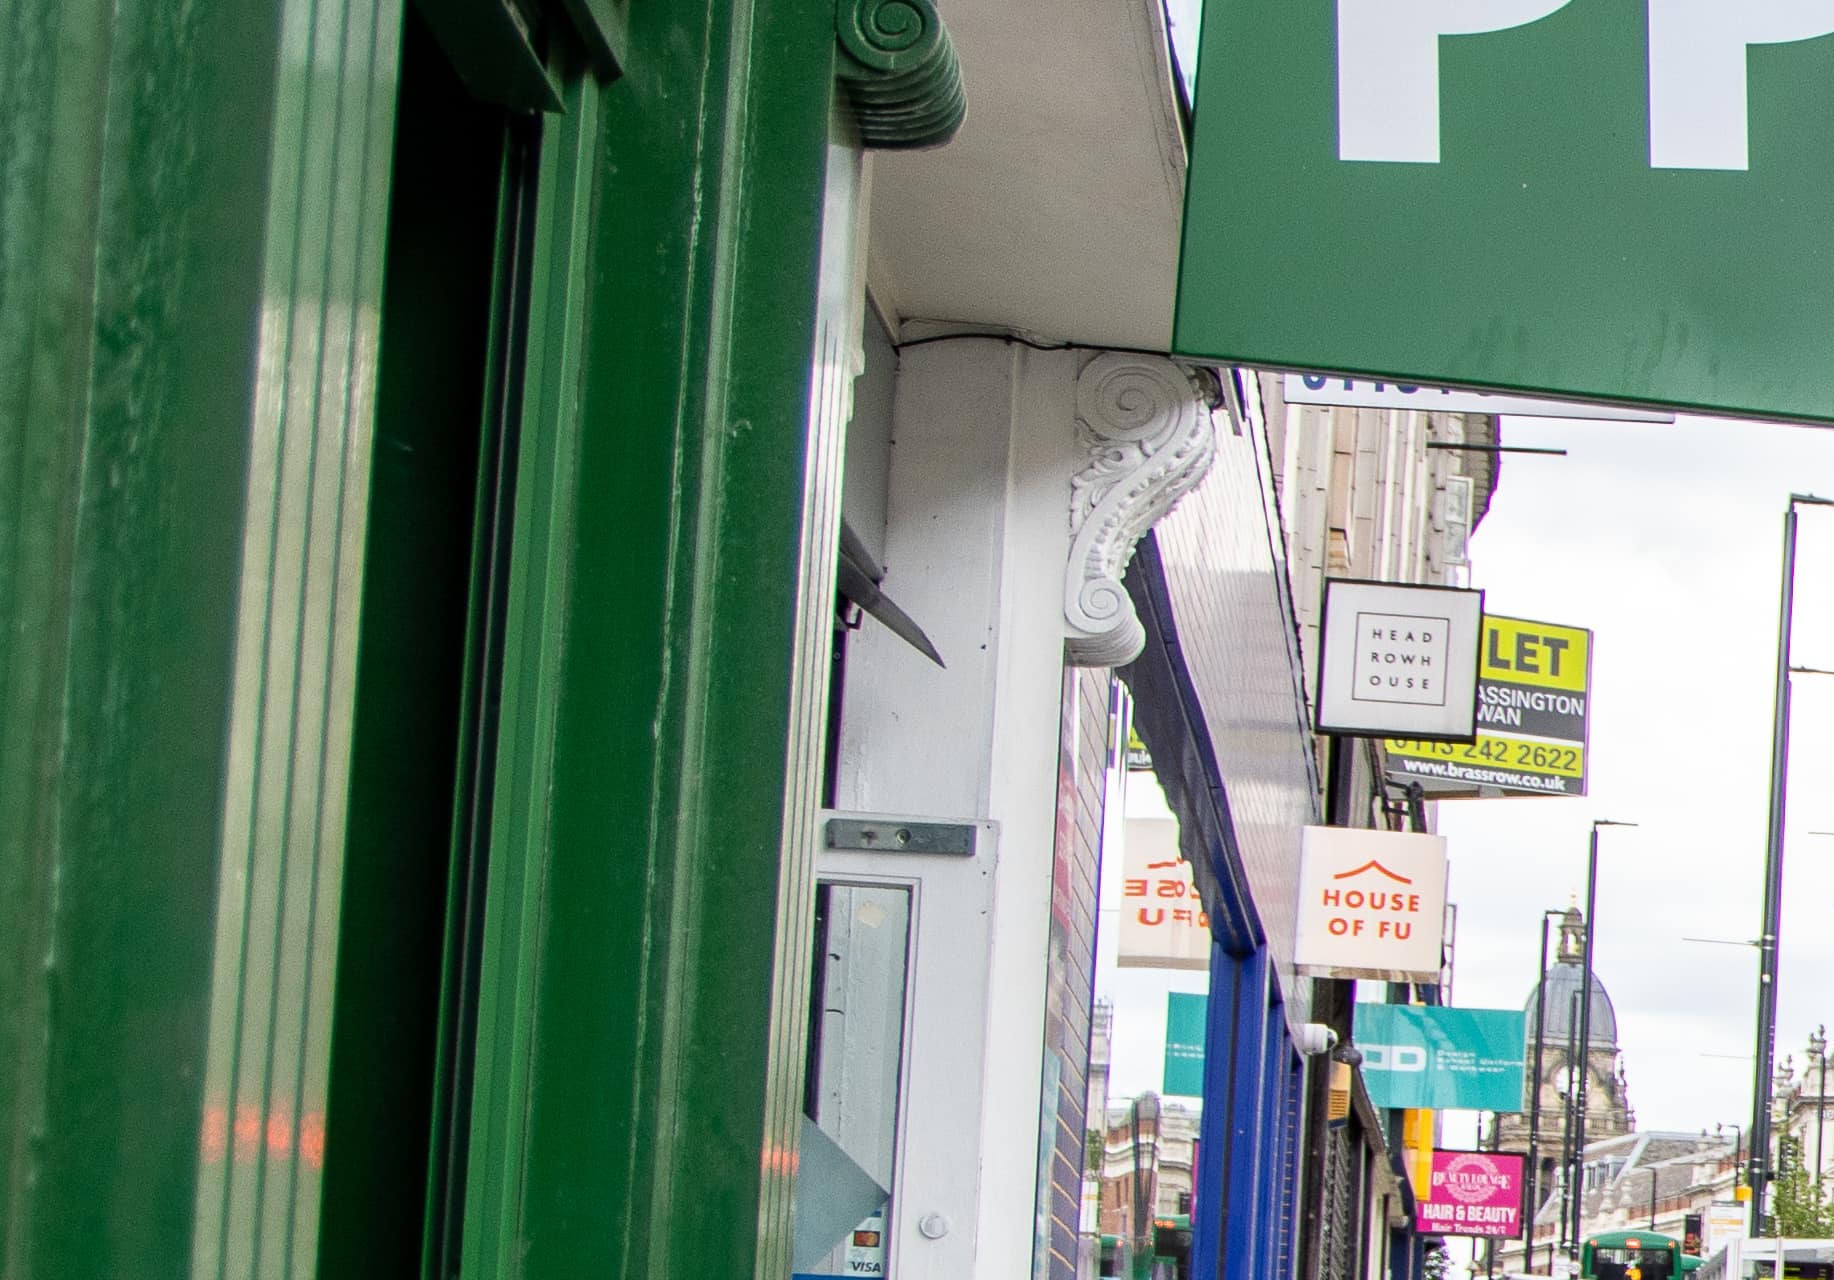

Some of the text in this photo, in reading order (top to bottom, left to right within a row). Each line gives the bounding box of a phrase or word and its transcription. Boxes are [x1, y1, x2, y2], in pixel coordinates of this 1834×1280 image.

[1372, 627, 1433, 645] HEAD
[1370, 650, 1432, 667] ROWH
[1487, 628, 1569, 677] LET
[1369, 674, 1430, 691] OUSE
[1463, 739, 1577, 771] 242 2622
[1404, 759, 1566, 791] www.brassrow.co.uk
[1322, 889, 1420, 913] HOUSE
[1328, 918, 1412, 940] OF FU
[1423, 1203, 1517, 1223] HAIR BEAUTY
[852, 1260, 881, 1273] VISA
